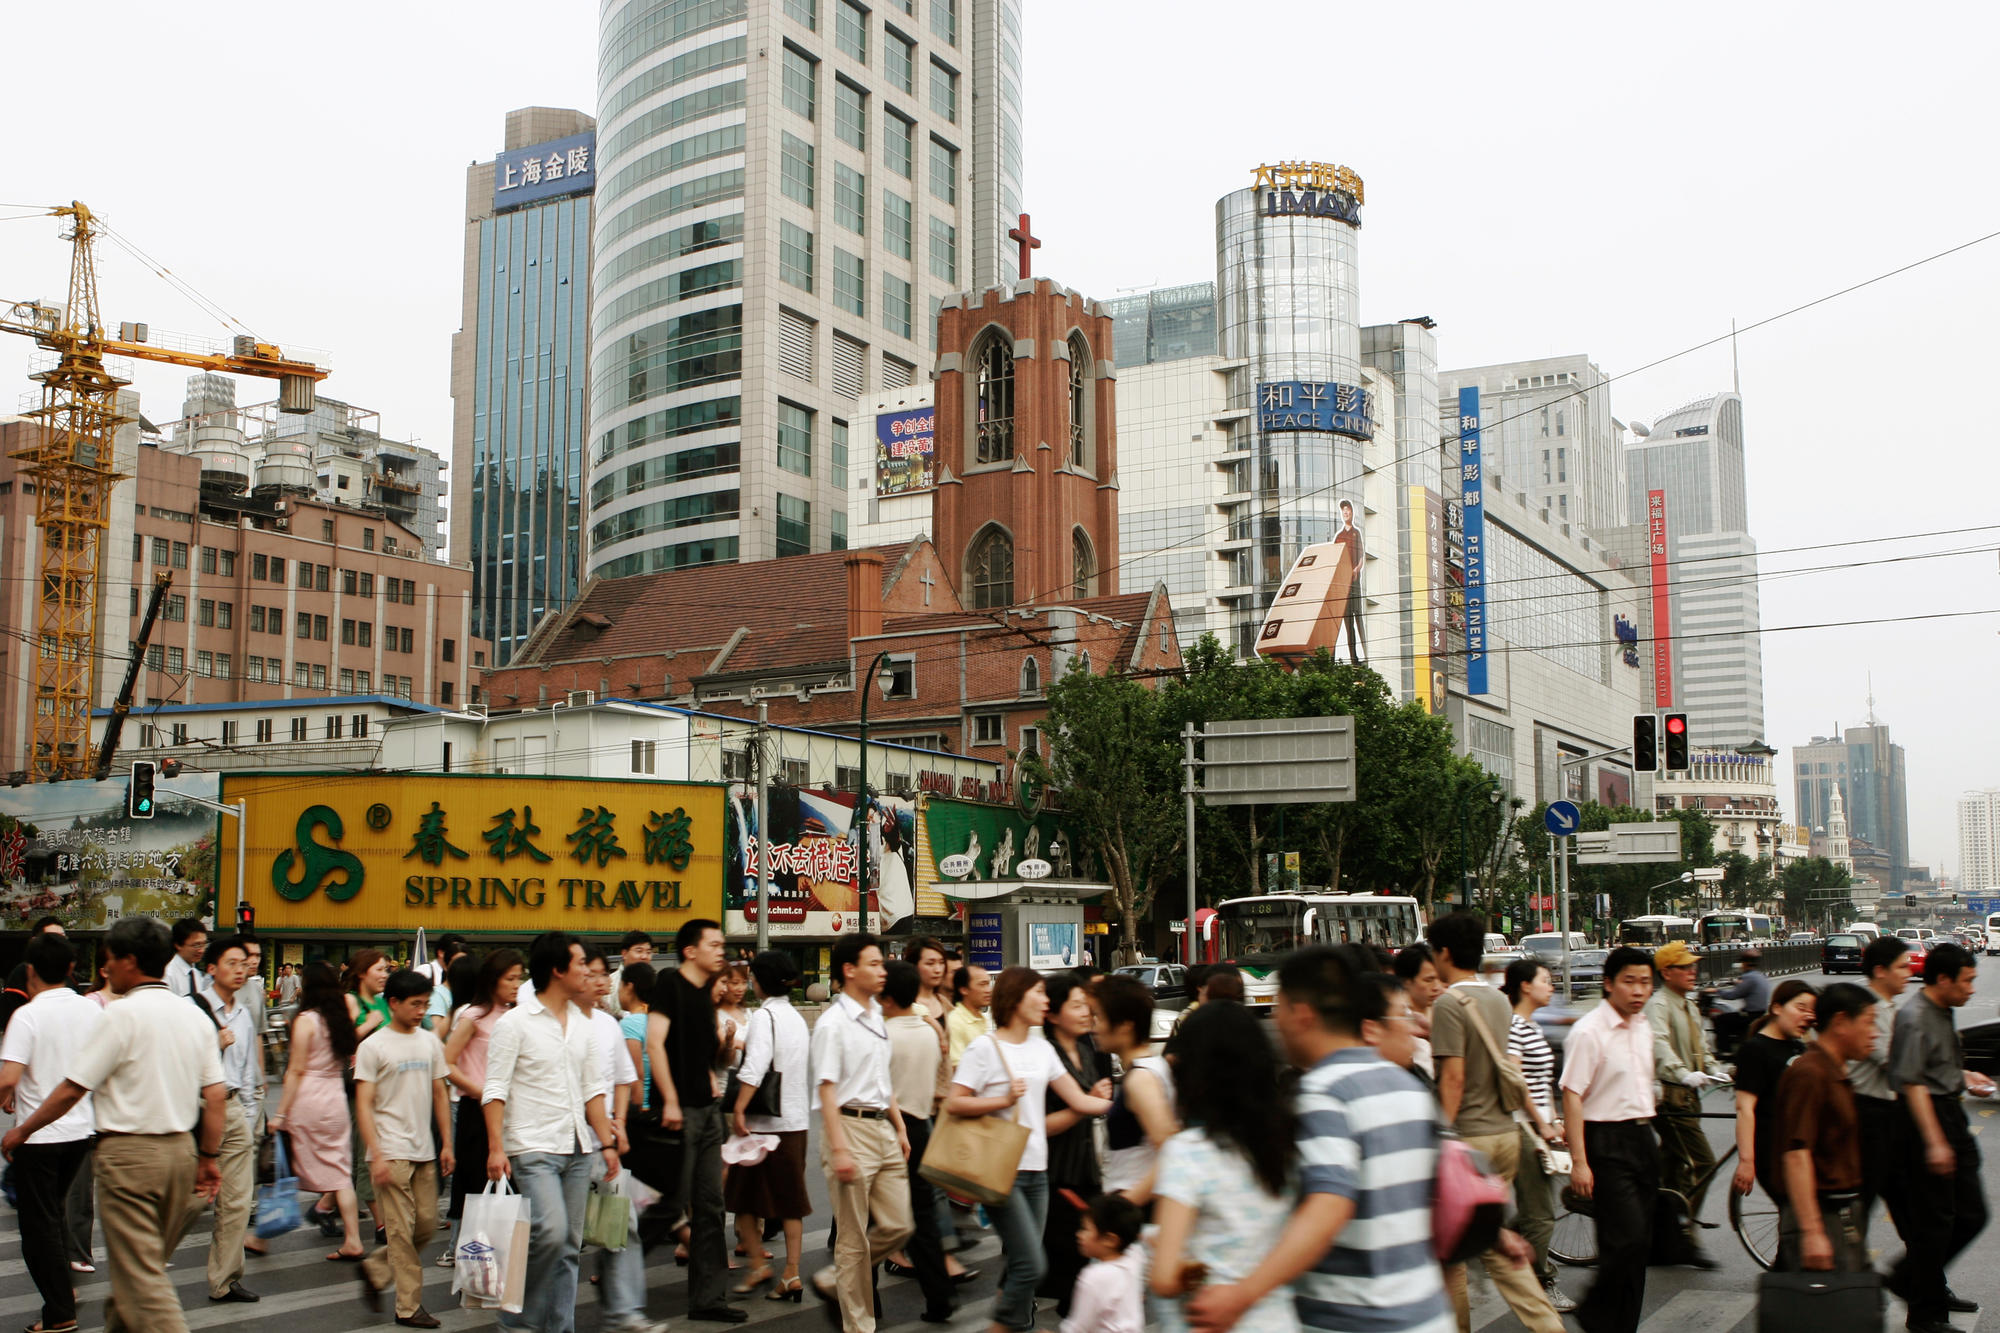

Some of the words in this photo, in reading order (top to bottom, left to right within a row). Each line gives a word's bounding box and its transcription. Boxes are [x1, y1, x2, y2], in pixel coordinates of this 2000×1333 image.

[498, 146, 589, 192] 上海金陵
[1267, 191, 1361, 227] IMAX
[1263, 411, 1321, 429] PEACE
[1461, 415, 1481, 507] 和平影都
[1466, 536, 1480, 588] PEACE
[1468, 598, 1482, 662] CINEMA
[402, 802, 695, 872] 春秋旅游
[404, 876, 546, 909] SPRING
[558, 879, 692, 909] TRAVEL
[750, 905, 803, 915] w.chmt.cn
[1251, 904, 1272, 914] 108
